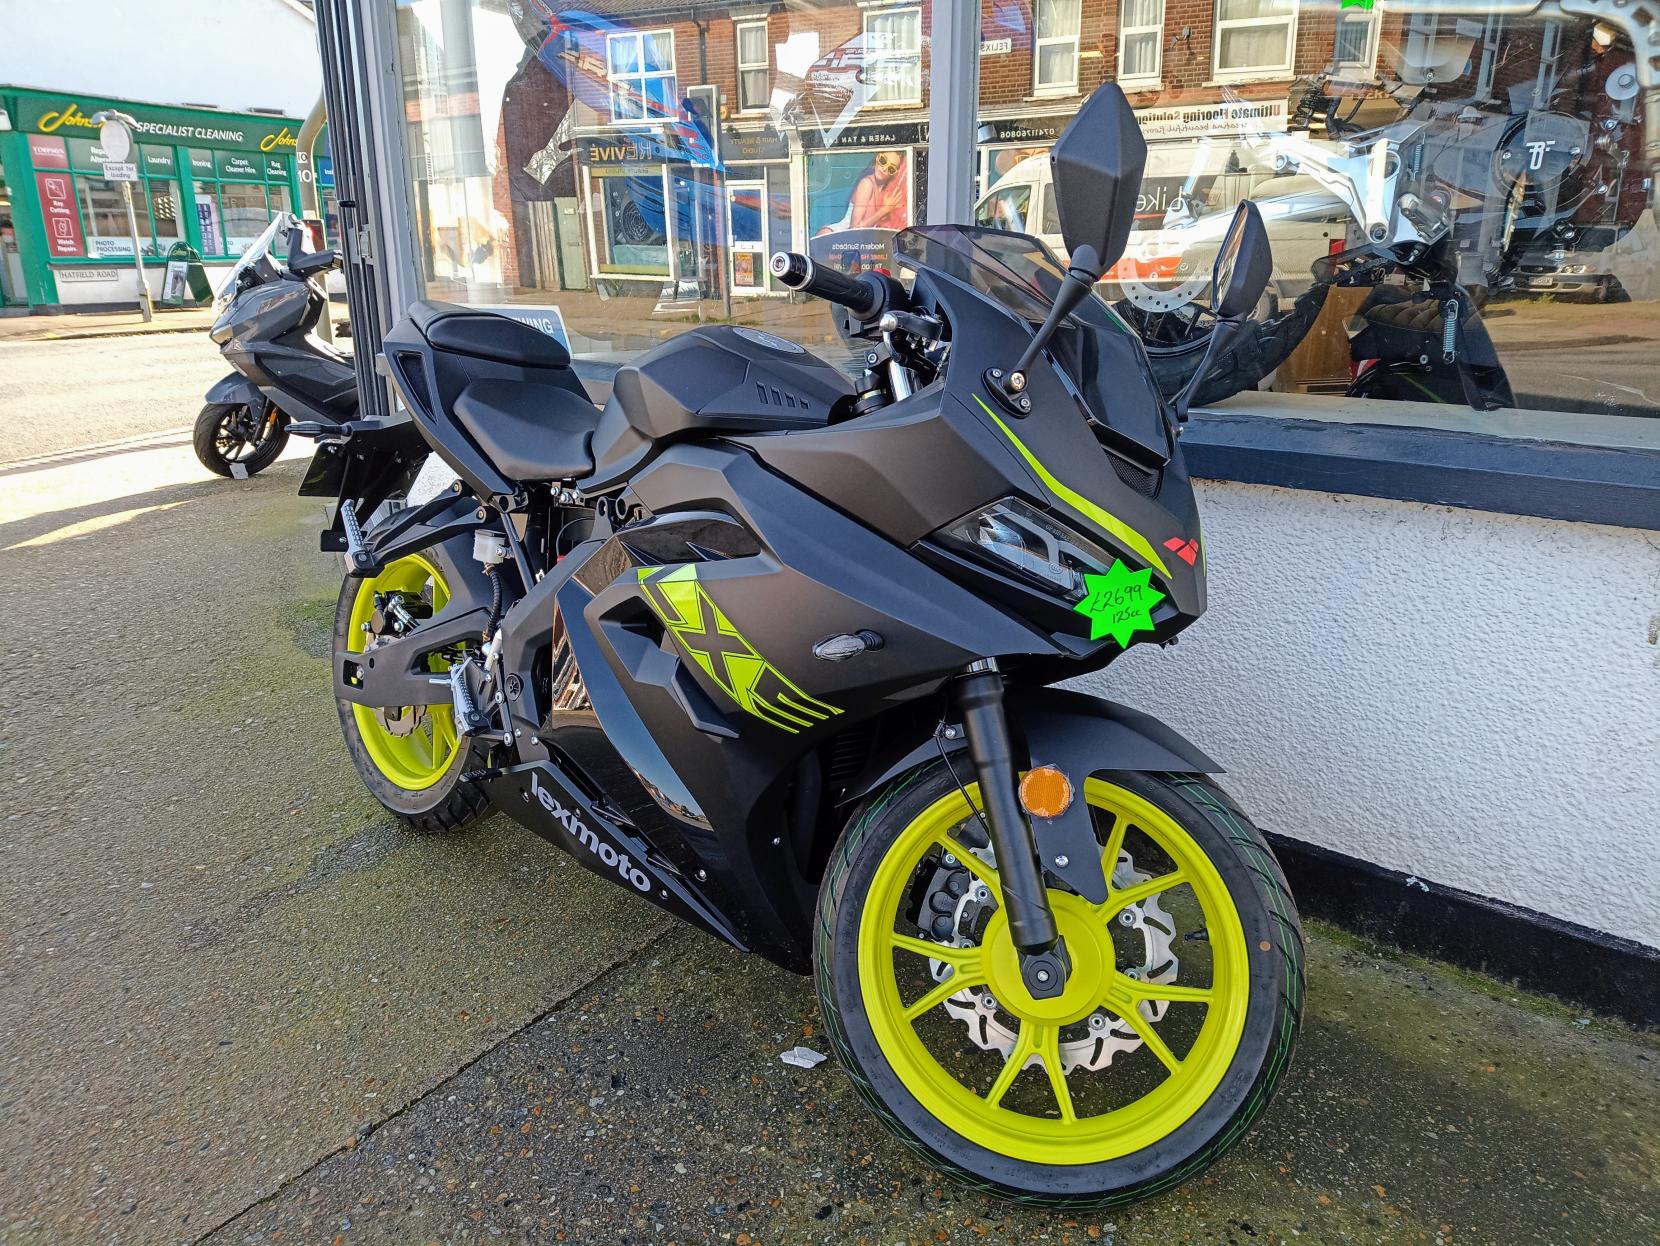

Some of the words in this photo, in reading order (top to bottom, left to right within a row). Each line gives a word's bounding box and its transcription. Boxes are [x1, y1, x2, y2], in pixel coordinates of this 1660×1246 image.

[38, 103, 105, 132] Johns
[136, 121, 195, 138] SPECIALIST
[194, 126, 244, 143] CLEANING
[259, 127, 298, 152] Johns
[147, 155, 171, 165] Laundry
[231, 157, 249, 166] Carpet
[270, 160, 281, 169] Rug
[105, 164, 124, 172] Except
[225, 165, 244, 174] Cleaner
[266, 168, 287, 177] Cleaning
[297, 169, 312, 183] 10
[61, 271, 95, 279] HATFIELD
[97, 270, 116, 279] ROAD
[1089, 584, 1143, 614] £2699
[1112, 606, 1144, 624] 125cc
[531, 771, 651, 893] lexmoto
